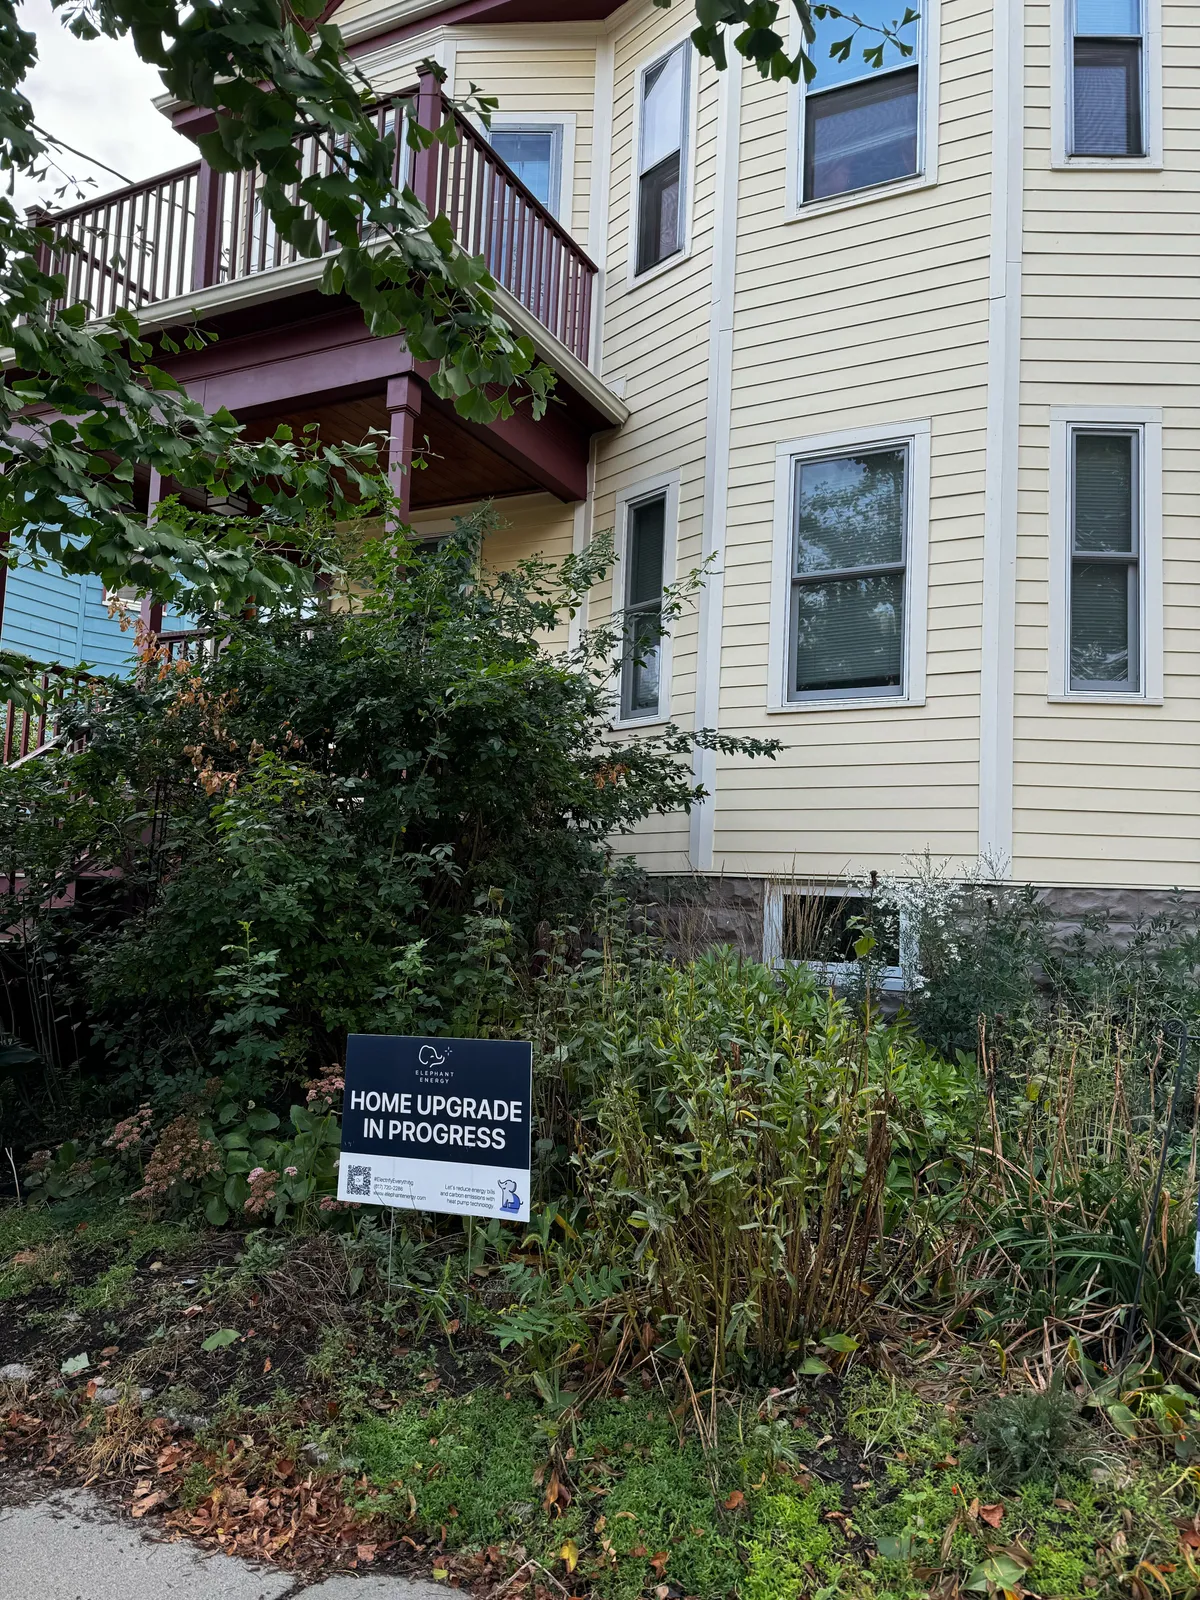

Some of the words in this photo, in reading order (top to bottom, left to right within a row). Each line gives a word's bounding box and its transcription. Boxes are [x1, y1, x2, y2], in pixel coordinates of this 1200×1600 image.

[350, 1090, 412, 1114] HOME
[417, 1094, 523, 1123] UPGRADE
[363, 1118, 384, 1139] IN
[388, 1120, 506, 1150] PROGRESS
